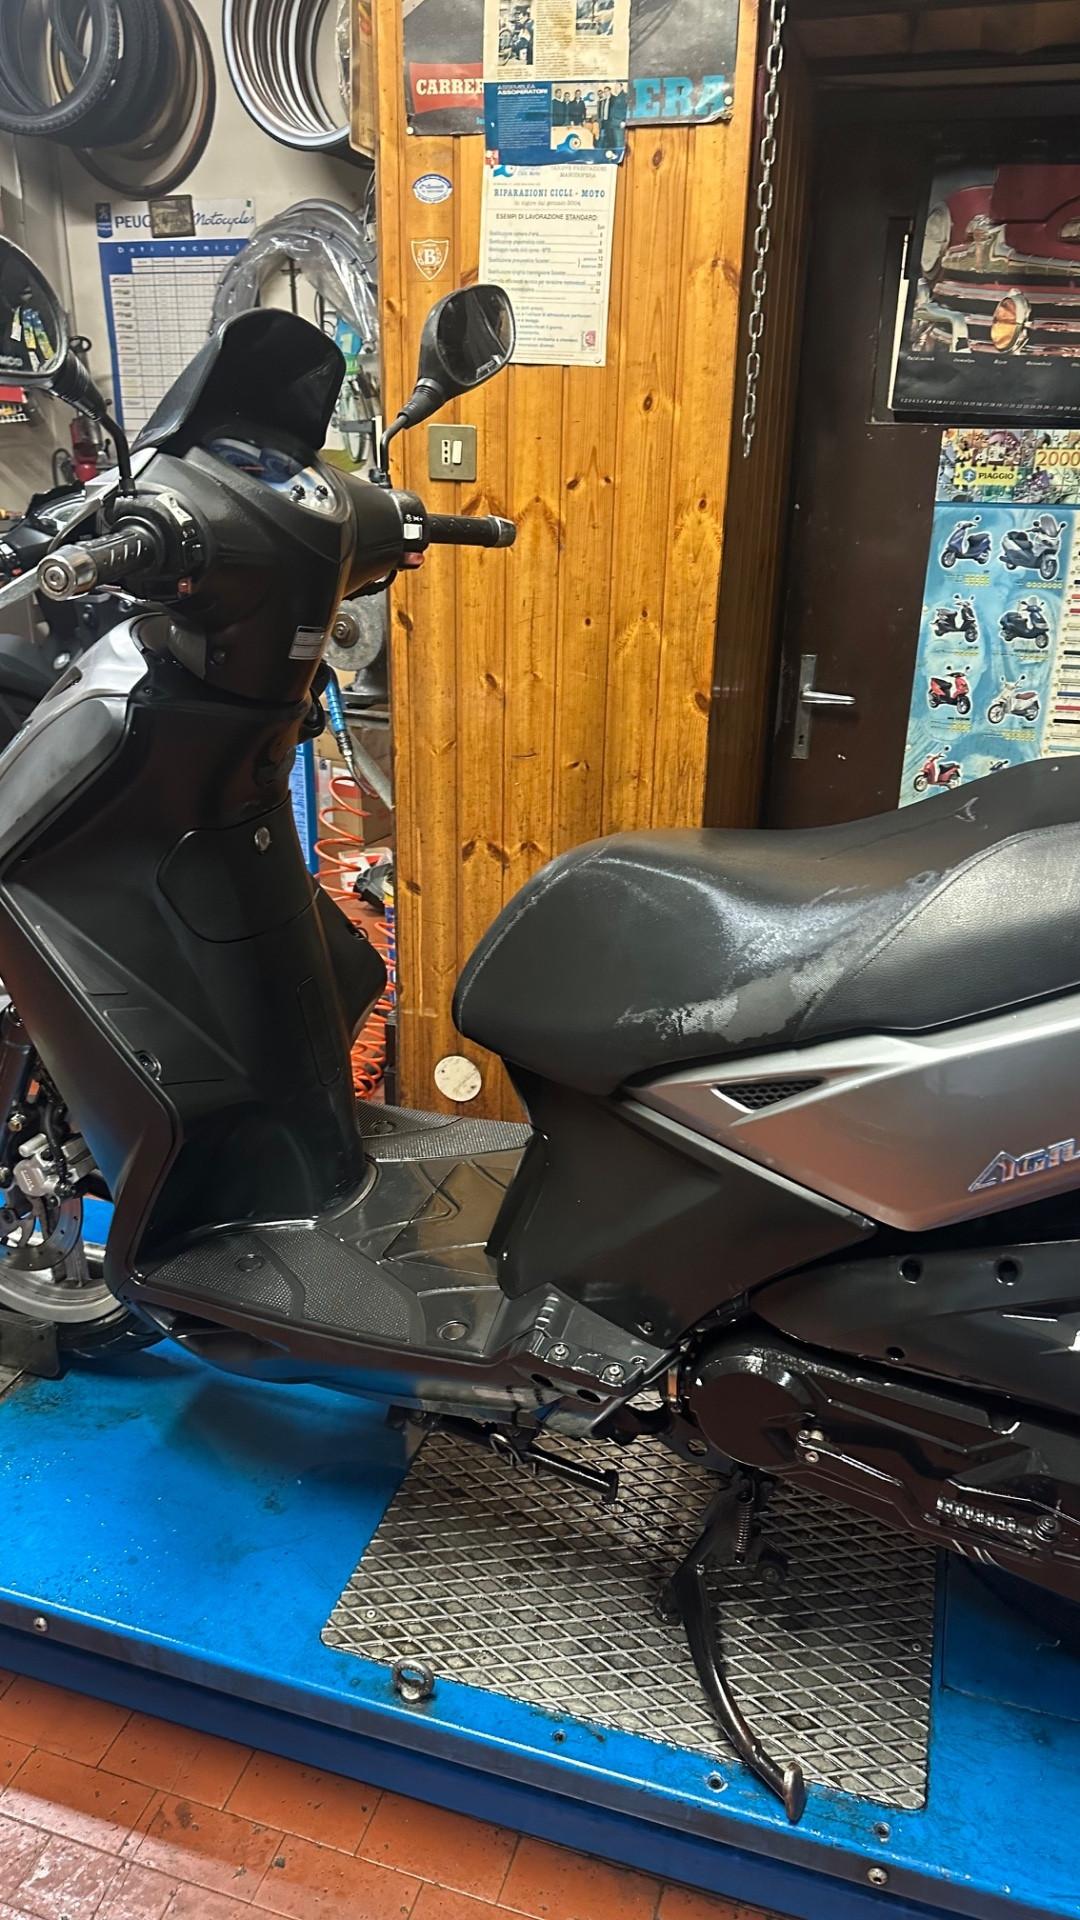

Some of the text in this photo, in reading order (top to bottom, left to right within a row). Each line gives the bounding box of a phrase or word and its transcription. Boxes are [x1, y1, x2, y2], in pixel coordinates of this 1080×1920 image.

[627, 74, 725, 118] ERA
[494, 188, 548, 198] RIPARAZIONI
[549, 188, 573, 198] CICLI
[581, 189, 606, 198] MOTO
[1037, 451, 1080, 467] 2000
[978, 472, 1014, 480] PIAGGIO
